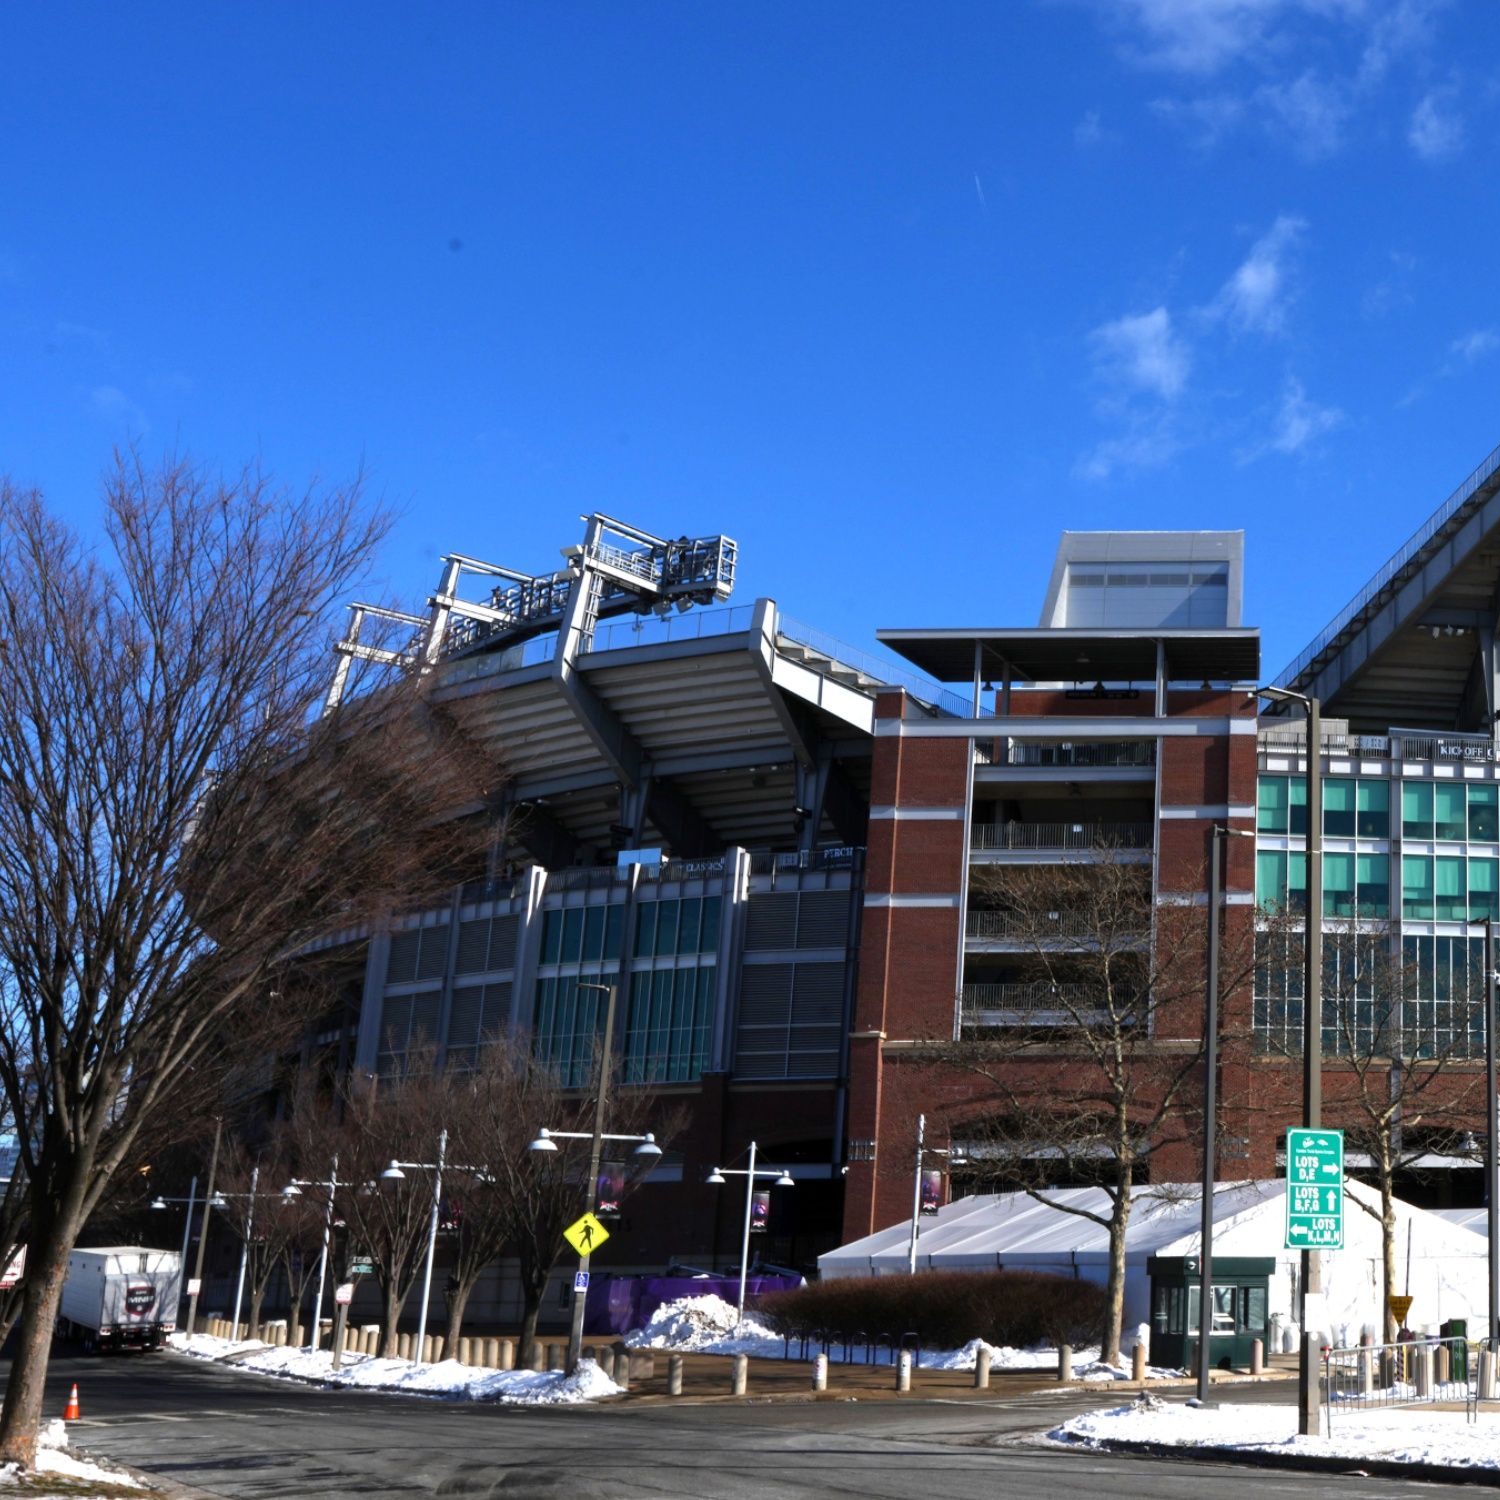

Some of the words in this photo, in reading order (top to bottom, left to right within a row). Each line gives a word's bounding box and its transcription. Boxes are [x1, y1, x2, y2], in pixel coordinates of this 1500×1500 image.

[1295, 1156, 1319, 1169] LOTS
[1299, 1168, 1316, 1182] D,E
[1295, 1186, 1320, 1199] LOTS
[1312, 1218, 1336, 1231] LOTS
